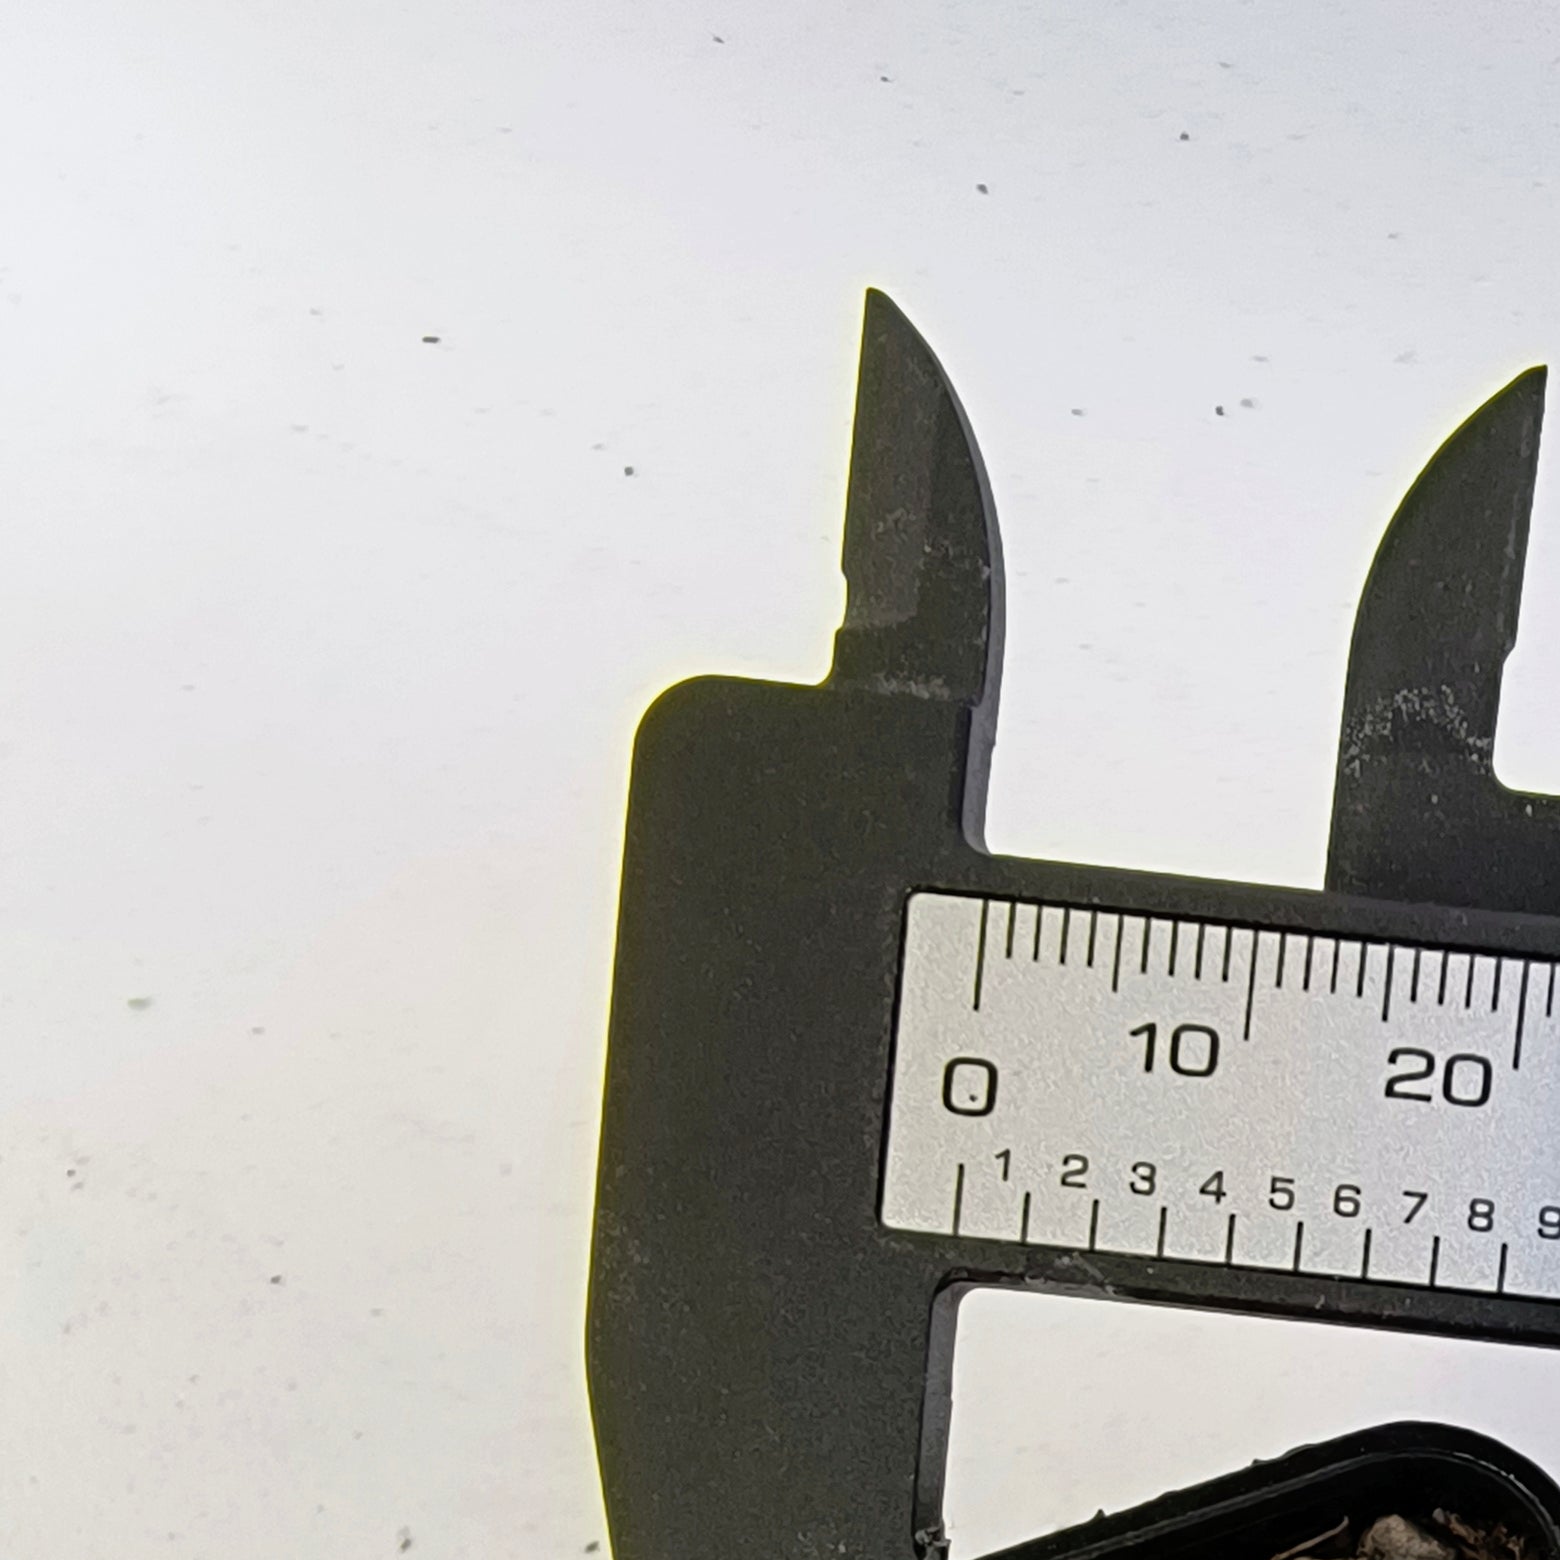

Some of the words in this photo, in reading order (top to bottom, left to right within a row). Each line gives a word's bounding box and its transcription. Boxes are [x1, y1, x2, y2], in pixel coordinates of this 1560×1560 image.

[942, 1056, 998, 1117] 0
[1129, 1021, 1221, 1078] 10
[1384, 1048, 1493, 1108] 20
[994, 1148, 1012, 1182] 1
[1060, 1154, 1090, 1189] 2
[1129, 1161, 1157, 1196] 3
[1199, 1169, 1228, 1205] 4
[1268, 1176, 1296, 1212] 5
[1332, 1184, 1362, 1218] 6
[1402, 1191, 1428, 1225] 7
[1467, 1198, 1496, 1233] 8
